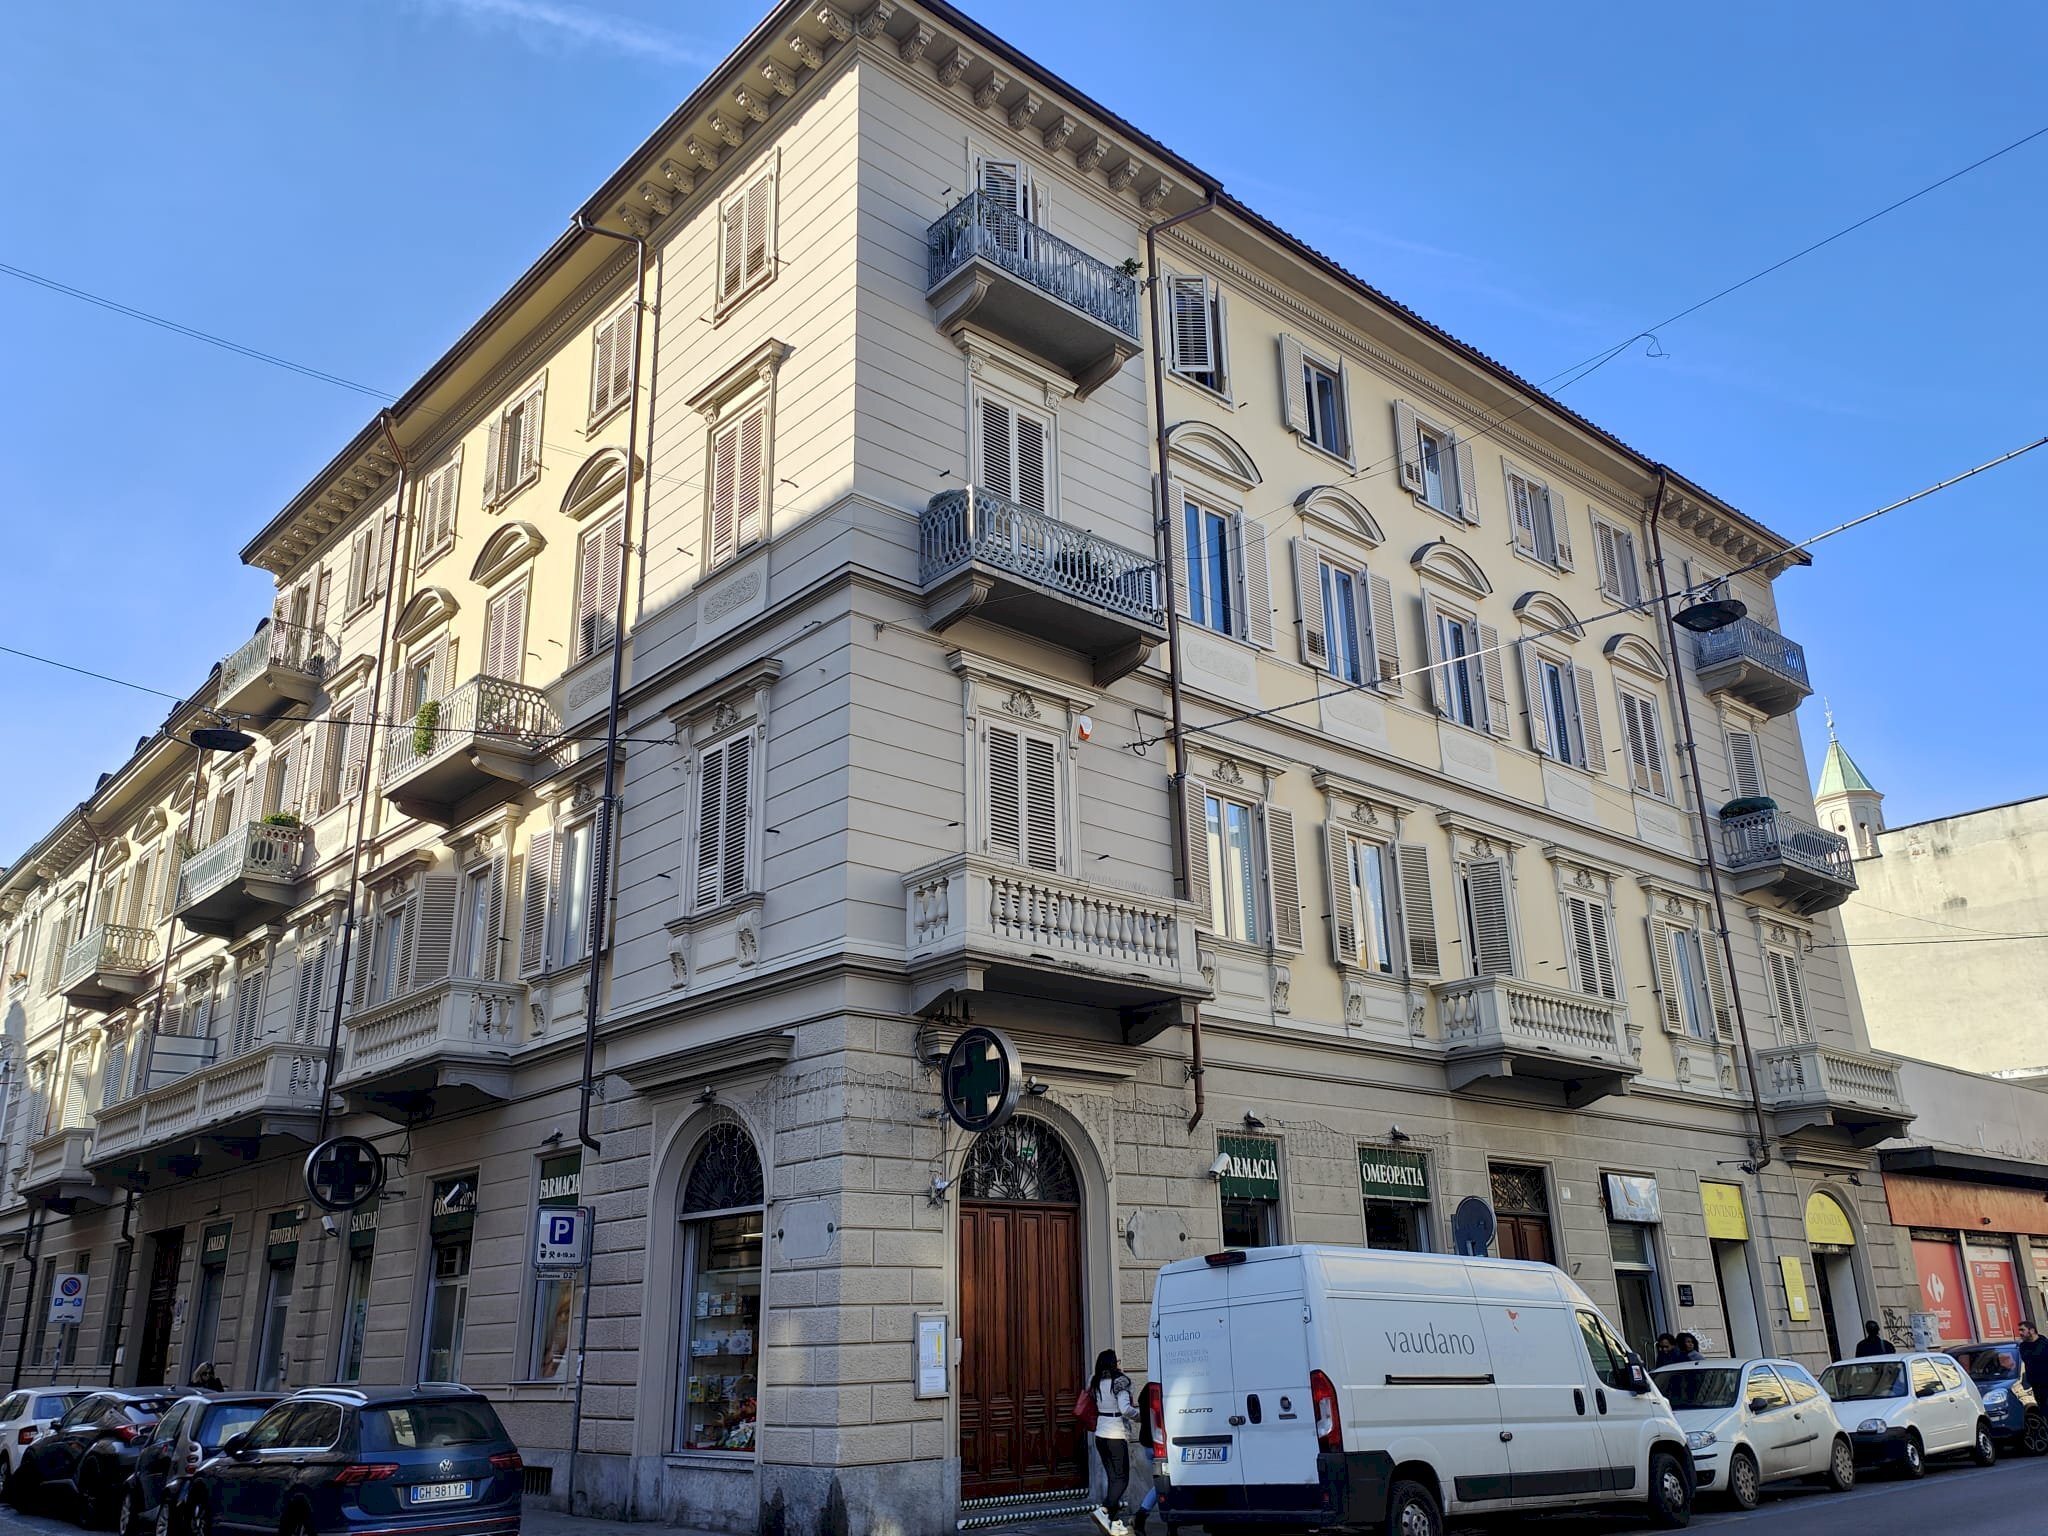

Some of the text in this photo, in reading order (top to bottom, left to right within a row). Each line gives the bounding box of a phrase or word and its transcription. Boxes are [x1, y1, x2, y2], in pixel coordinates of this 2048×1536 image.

[539, 1173, 580, 1200] FARMACIA
[1362, 1163, 1425, 1187] OMEOPATIA
[1703, 1203, 1743, 1219] GOVINDA
[1808, 1211, 1842, 1226] GOVINDA
[554, 1219, 570, 1242] P
[1164, 1329, 1201, 1343] vaudano
[1385, 1322, 1475, 1355] vaudano
